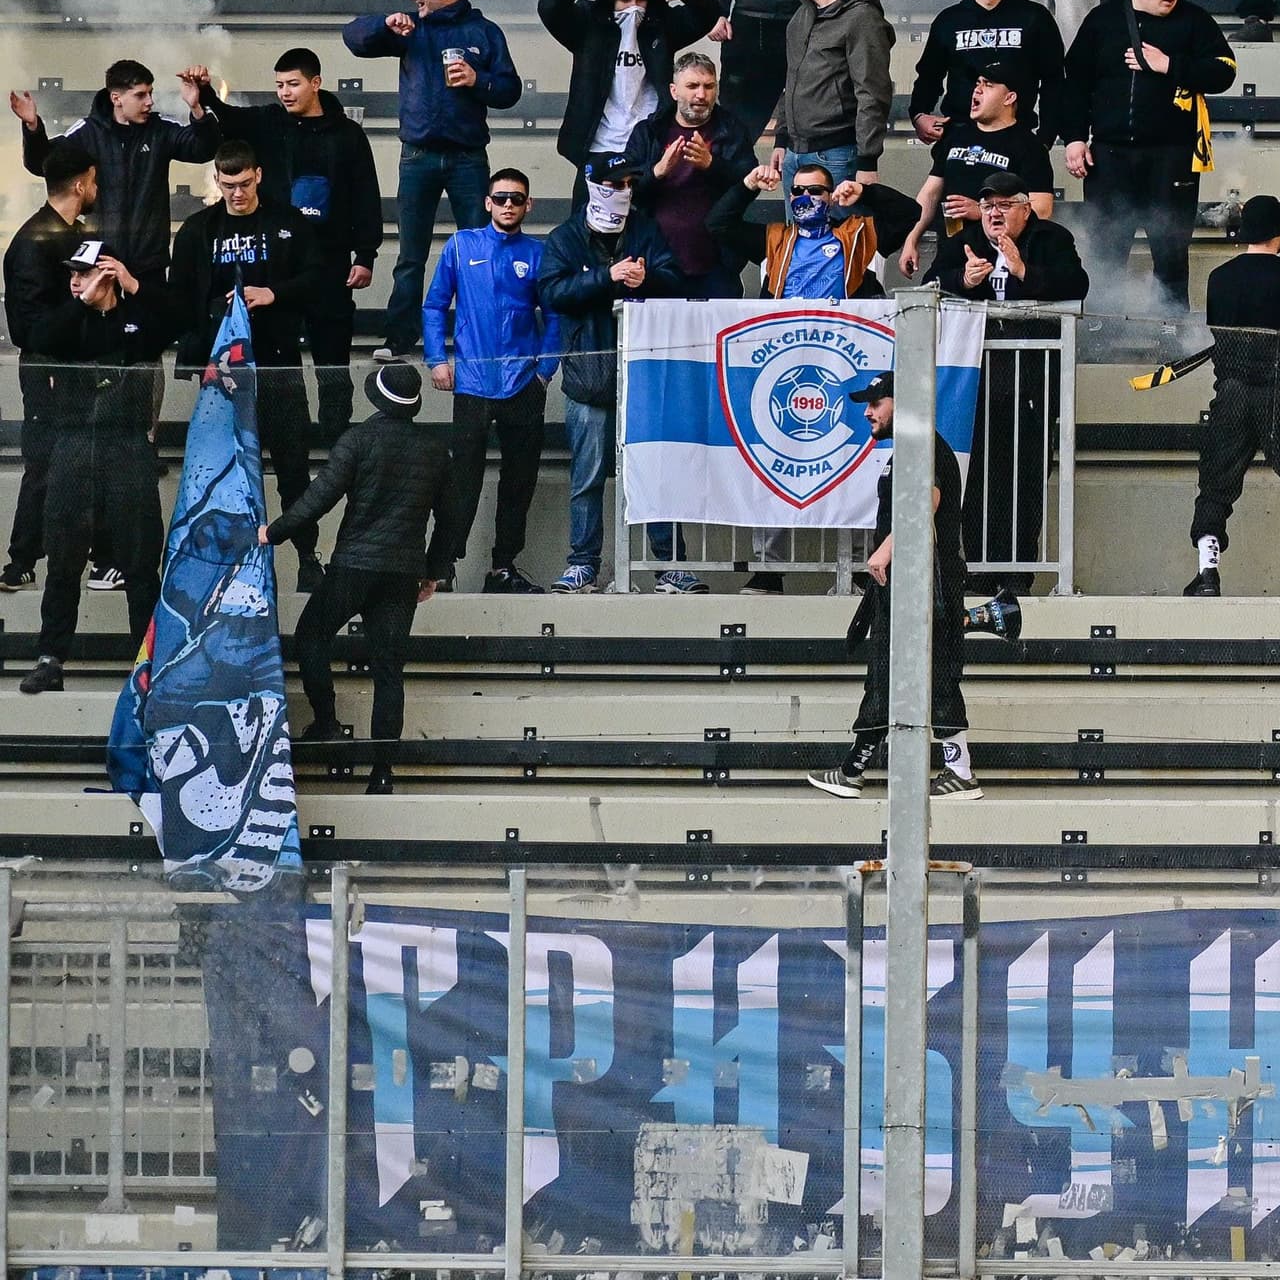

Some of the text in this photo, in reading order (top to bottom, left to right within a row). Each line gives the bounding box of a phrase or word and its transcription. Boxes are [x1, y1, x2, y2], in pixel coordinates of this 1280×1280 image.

[998, 30, 1022, 47] 18
[616, 51, 643, 67] fbe
[981, 151, 1010, 169] HATED
[781, 327, 869, 368] СПАРТАК
[792, 396, 825, 411] 1918
[770, 458, 834, 478] ВАРНА
